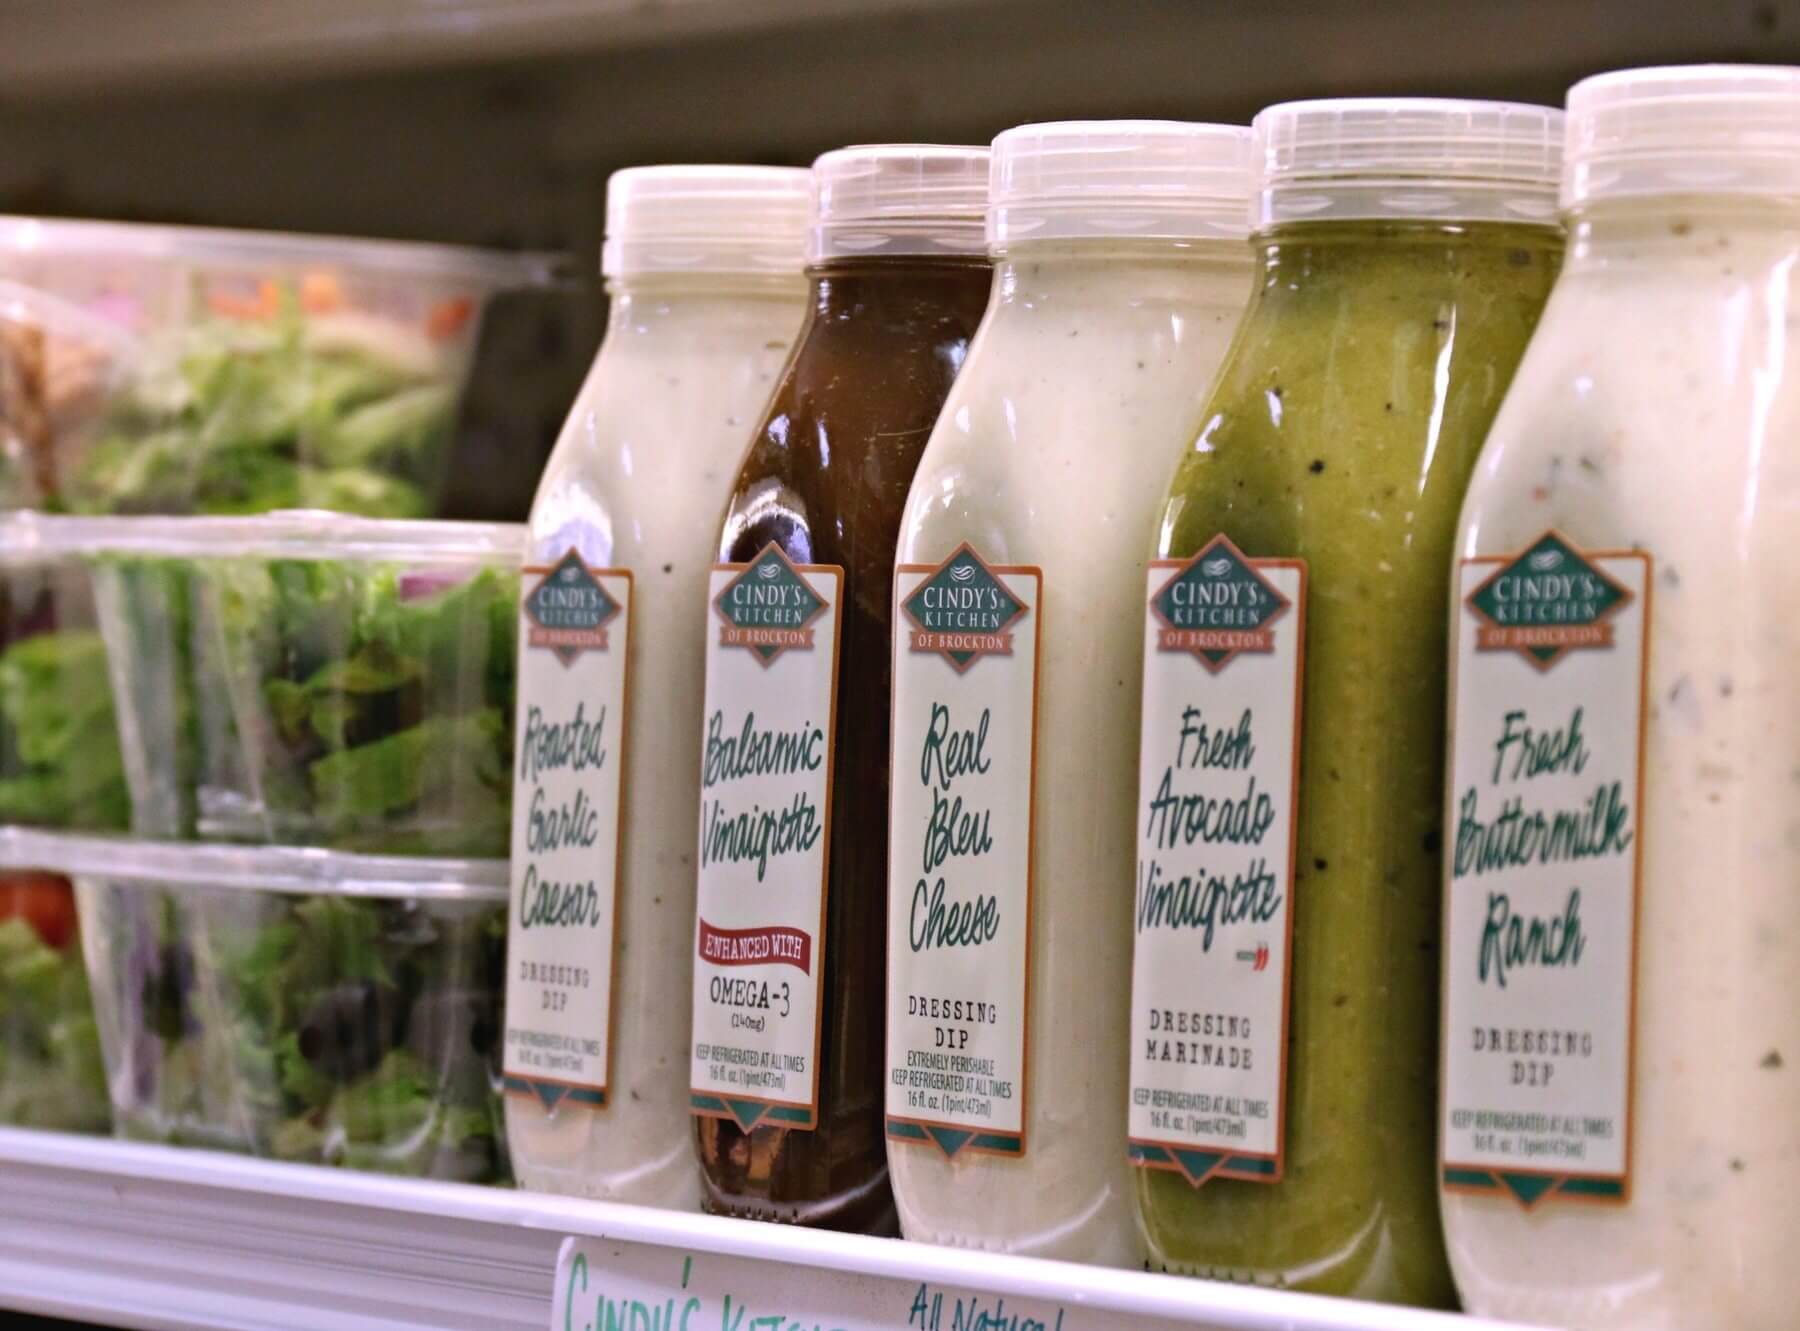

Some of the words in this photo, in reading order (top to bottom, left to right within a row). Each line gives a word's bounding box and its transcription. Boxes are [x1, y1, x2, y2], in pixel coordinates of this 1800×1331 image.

[538, 586, 598, 608] CINDY'S
[733, 584, 802, 606] CINDY'S
[923, 586, 999, 610] CINDY'S
[1171, 582, 1258, 606] CINDY'S
[1493, 574, 1594, 602] CINDY'S
[734, 607, 802, 624] KITCHEN
[925, 611, 1000, 628] KITCHEN
[1173, 608, 1260, 625] KITCHEN
[1496, 602, 1596, 621] KITCHEN
[728, 629, 741, 641] OF
[746, 629, 806, 645] BROCKTON
[918, 633, 933, 648] OF
[938, 634, 1004, 650] BROCKTON
[1165, 631, 1183, 647] OF
[1189, 631, 1264, 648] BROCKTON
[521, 701, 606, 783] Roasted
[703, 709, 823, 788] Balsamic
[920, 701, 991, 791] Real
[1176, 704, 1256, 770] Fresh
[1492, 706, 1590, 785] Fresh
[527, 786, 599, 855] Garlic
[1146, 765, 1275, 850] Avocado
[702, 791, 822, 883] Vinaigrette
[923, 786, 993, 874] Bleu
[1454, 782, 1634, 878] Buttermilk
[520, 863, 600, 929] Caesar
[1138, 858, 1282, 953] Vinaigrette
[910, 877, 1000, 953] Cheese
[705, 934, 769, 960] ENHANCED
[772, 934, 803, 960] WITH
[1478, 887, 1586, 989] Ranch
[520, 960, 590, 989] DRESSING
[541, 989, 569, 1013] DIP
[710, 975, 790, 1017] OMEGA-3
[908, 995, 996, 1024] DRESSING
[935, 1027, 969, 1049] DIP
[1149, 1008, 1251, 1039] DRESSING
[1146, 1039, 1253, 1071] MARINADE
[1472, 1026, 1592, 1058] DRESSING
[711, 1045, 759, 1067] REFRIGERATED
[760, 1051, 769, 1069] AT
[770, 1053, 782, 1070] ALL
[784, 1054, 805, 1073] TIMES
[907, 1050, 949, 1070] EXTREMELY
[950, 1055, 994, 1077] PERISHABLE
[1511, 1060, 1555, 1086] DIP
[892, 1068, 908, 1085] KEEP
[909, 1070, 964, 1092] REFRIGERATED
[966, 1077, 975, 1094] AT
[975, 1078, 988, 1096] ALL
[989, 1079, 1012, 1099] TIMES
[908, 1091, 917, 1108] 16
[928, 1096, 940, 1110] oz.
[1225, 1096, 1241, 1116] ALL
[1243, 1098, 1269, 1119] TIMES
[909, 1283, 943, 1331] All
